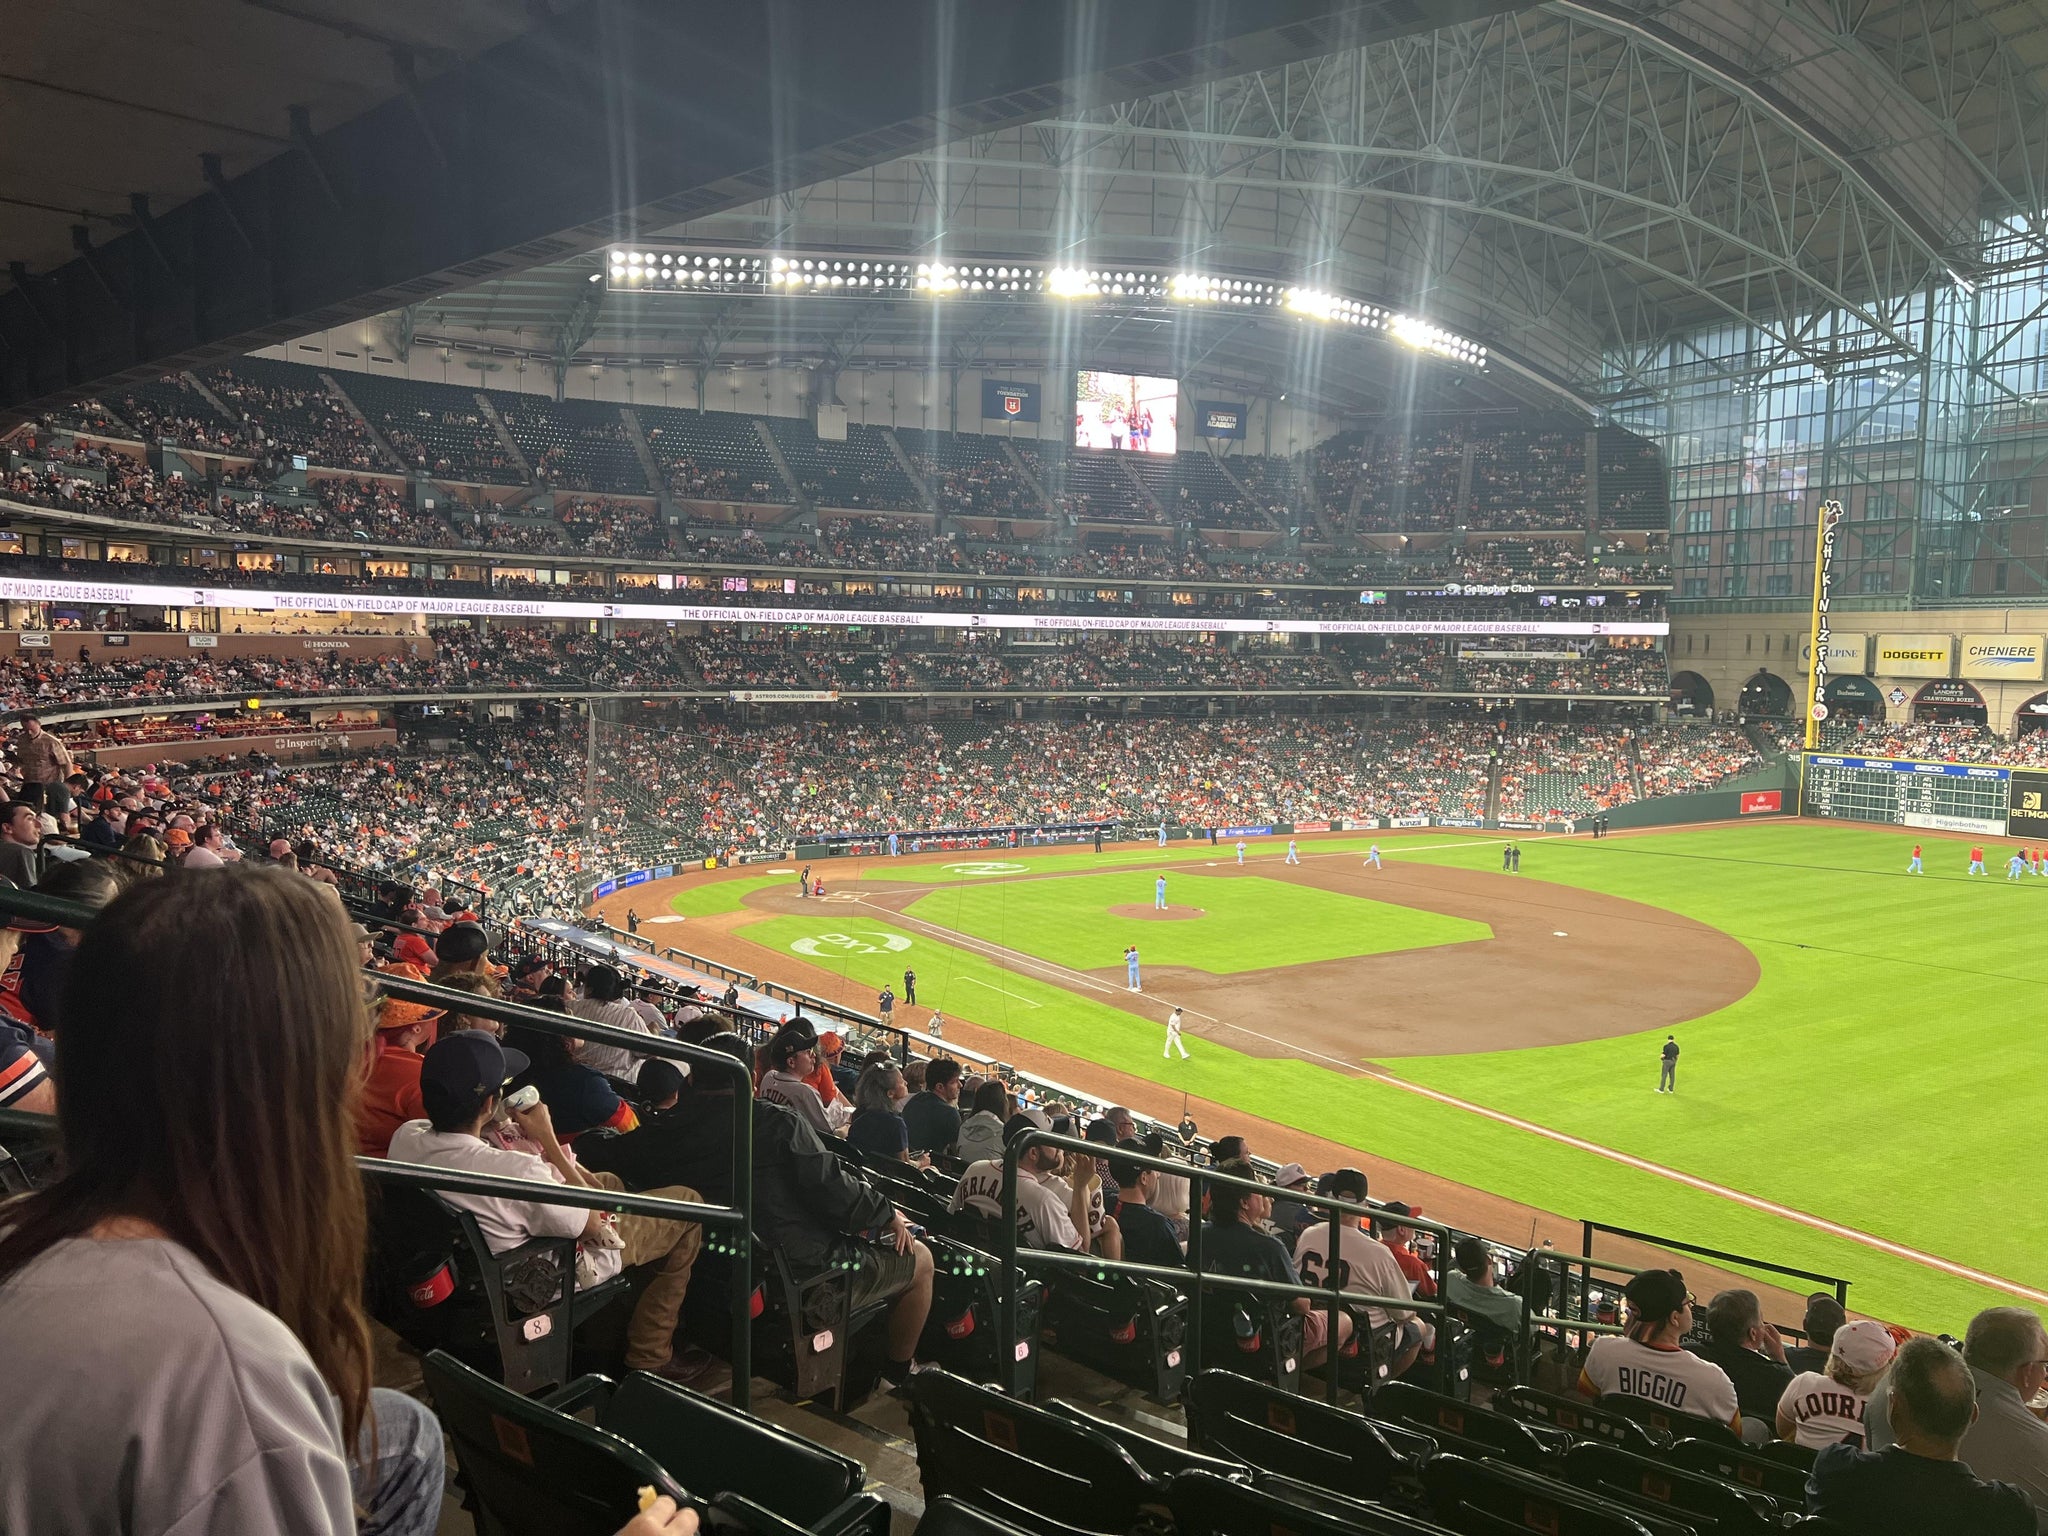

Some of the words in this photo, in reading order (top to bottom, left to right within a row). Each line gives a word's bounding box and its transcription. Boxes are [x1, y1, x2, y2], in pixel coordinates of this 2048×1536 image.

[2, 582, 13, 596] OF
[15, 583, 42, 598] MAJOR
[44, 585, 82, 599] LEAGUE
[1464, 584, 1509, 594] Gallagher
[1511, 584, 1535, 593] Club
[274, 596, 293, 607] THE
[295, 597, 339, 608] OFFICIAL
[341, 598, 382, 610] ON-FIELD
[384, 600, 403, 611] CAP
[406, 600, 418, 611] OF
[421, 601, 453, 612] MAJOR
[455, 602, 491, 613] LEAGUE
[683, 609, 700, 618] THE
[702, 609, 741, 619] OFFICIAL
[744, 610, 783, 620] ON-FIELD
[785, 612, 802, 621] CAP
[804, 612, 815, 621] OF
[817, 613, 845, 622] MAJOR
[846, 614, 877, 623] LEAGUE
[1034, 618, 1048, 627] THE
[1050, 618, 1081, 628] OFFICIAL
[1082, 619, 1113, 628] ON-FIELD
[1115, 620, 1129, 628] CAP
[1130, 620, 1139, 628] OF
[1140, 620, 1163, 629] MAJOR
[1164, 621, 1190, 629] LEAGUE
[1319, 623, 1331, 631] THE
[1332, 623, 1366, 631] OFFICIAL
[1434, 624, 1461, 632] MAJOR
[1462, 624, 1493, 632] LEAGUE
[1883, 651, 1943, 660] DOGGETT
[1969, 646, 2036, 657] CHENIERE
[287, 738, 321, 749] Insperit
[1787, 754, 1801, 762] 315
[1936, 818, 1988, 830] Higginbotham
[533, 1319, 542, 1334] 8
[820, 1334, 826, 1347] 7
[1618, 1366, 1687, 1408] BIGGIO
